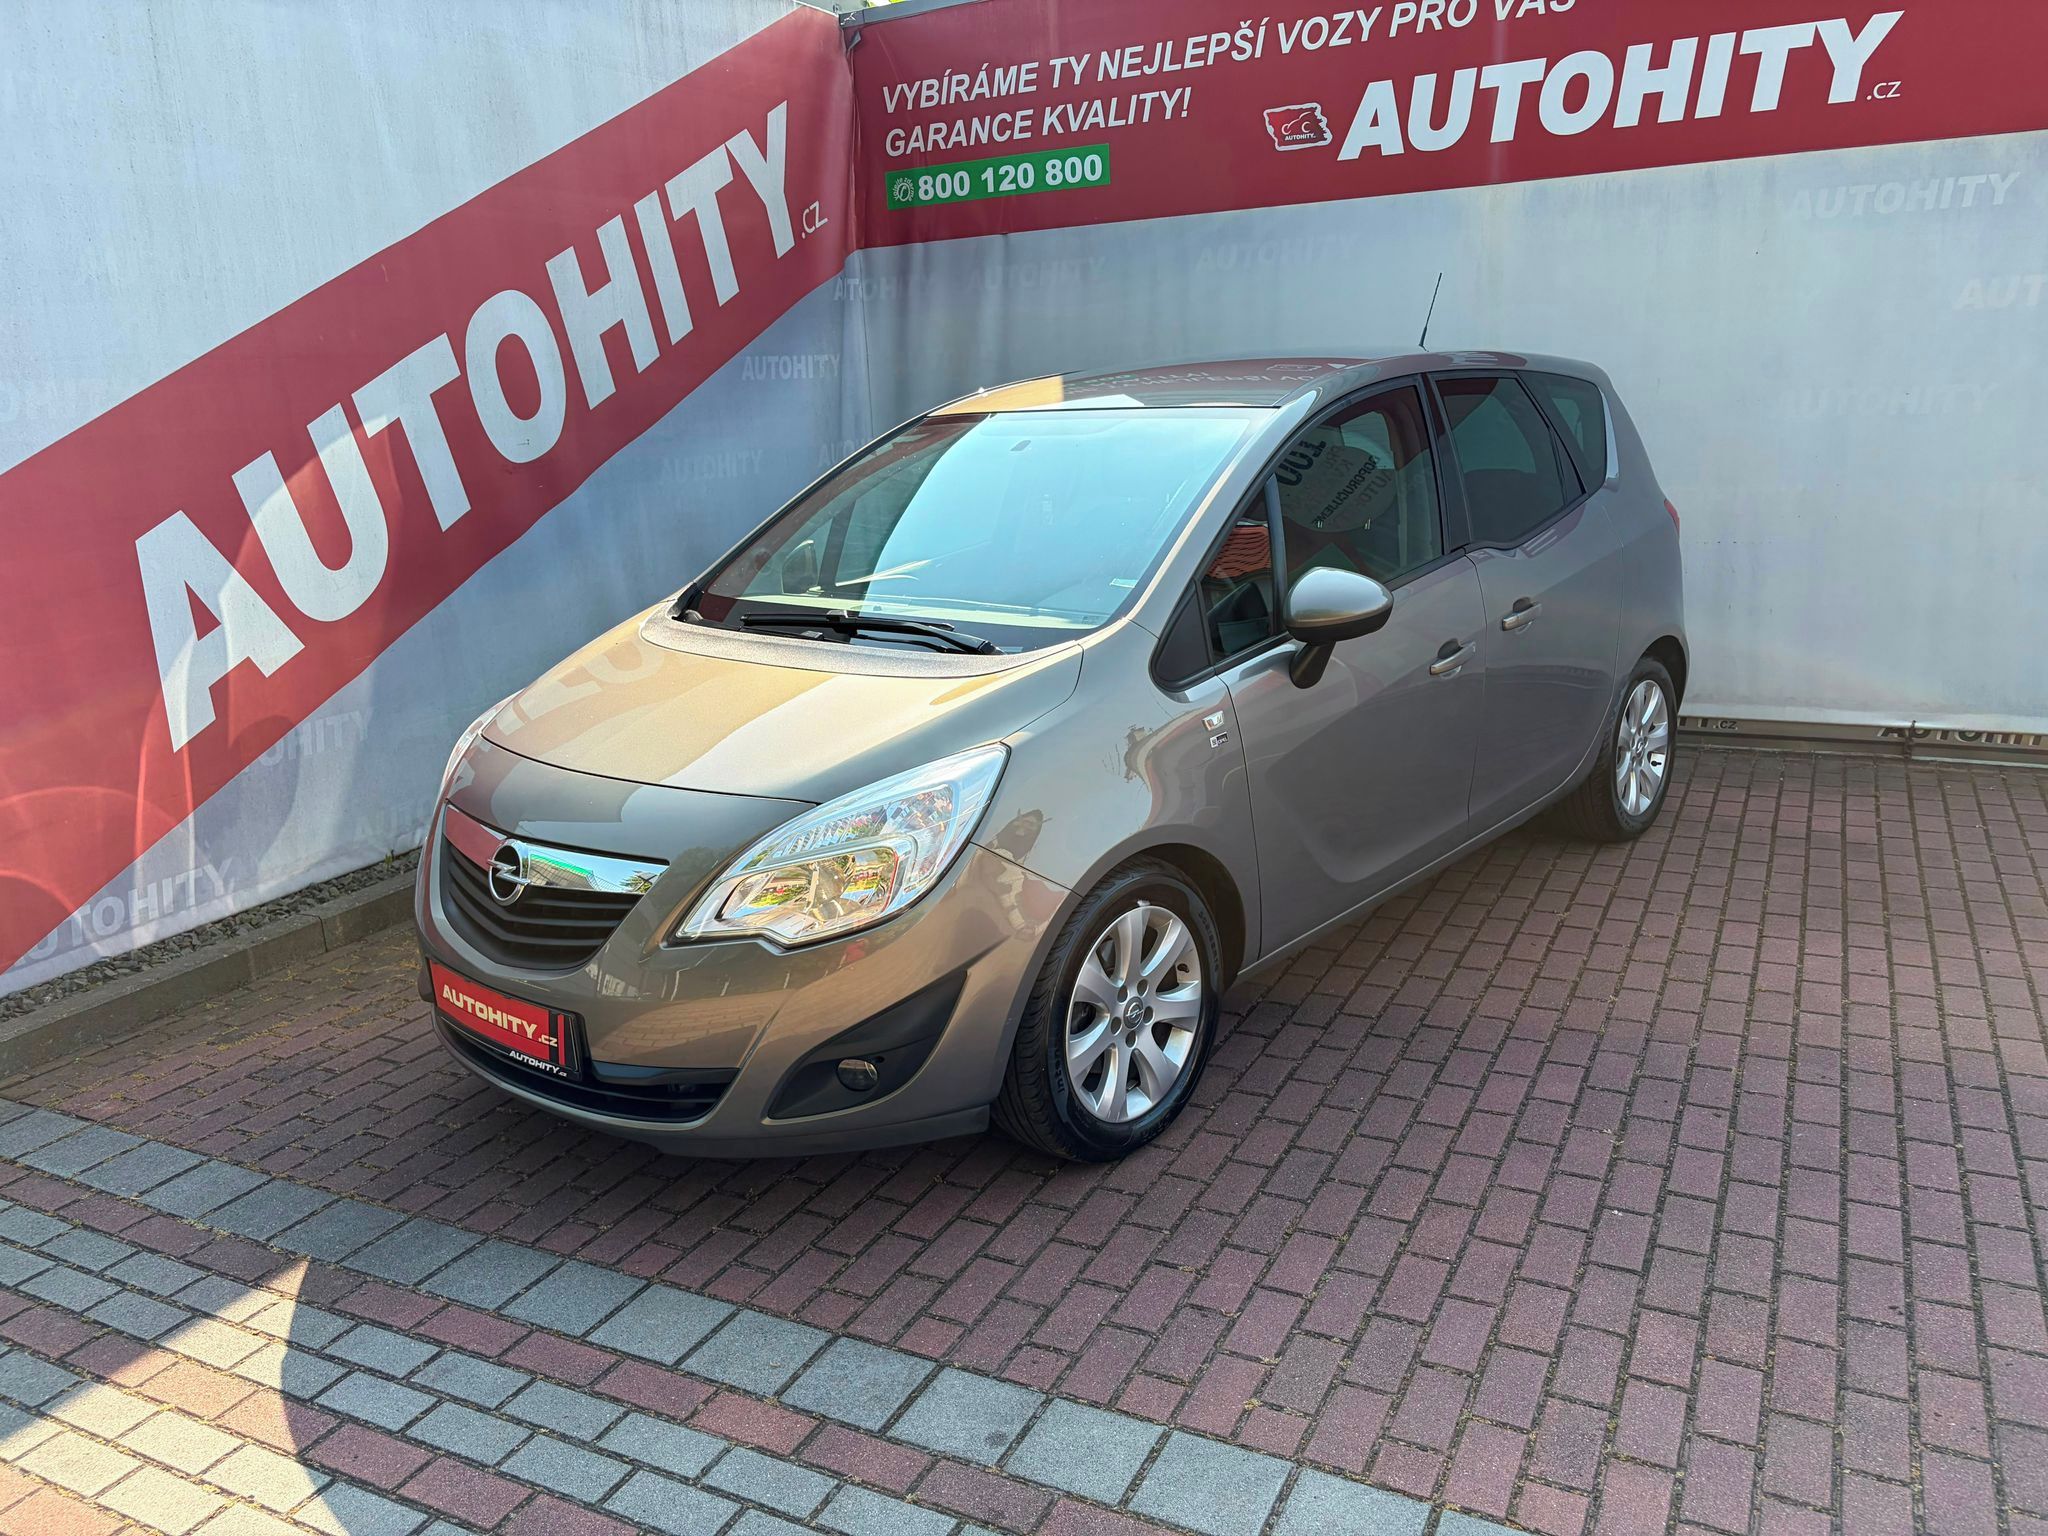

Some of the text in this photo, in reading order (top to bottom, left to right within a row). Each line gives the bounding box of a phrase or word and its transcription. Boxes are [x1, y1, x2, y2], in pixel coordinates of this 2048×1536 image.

[883, 61, 1038, 113] VYBÍRÁME
[1049, 53, 1090, 89] TY
[1098, 17, 1270, 82] NEJLEPŠÍ
[1277, 7, 1384, 54] VOZY
[1389, 0, 1478, 38] PRO
[885, 86, 1192, 157] GARANCE KVALITY!
[917, 154, 1103, 201] 800 120 800
[742, 353, 840, 381] AUTOHITY
